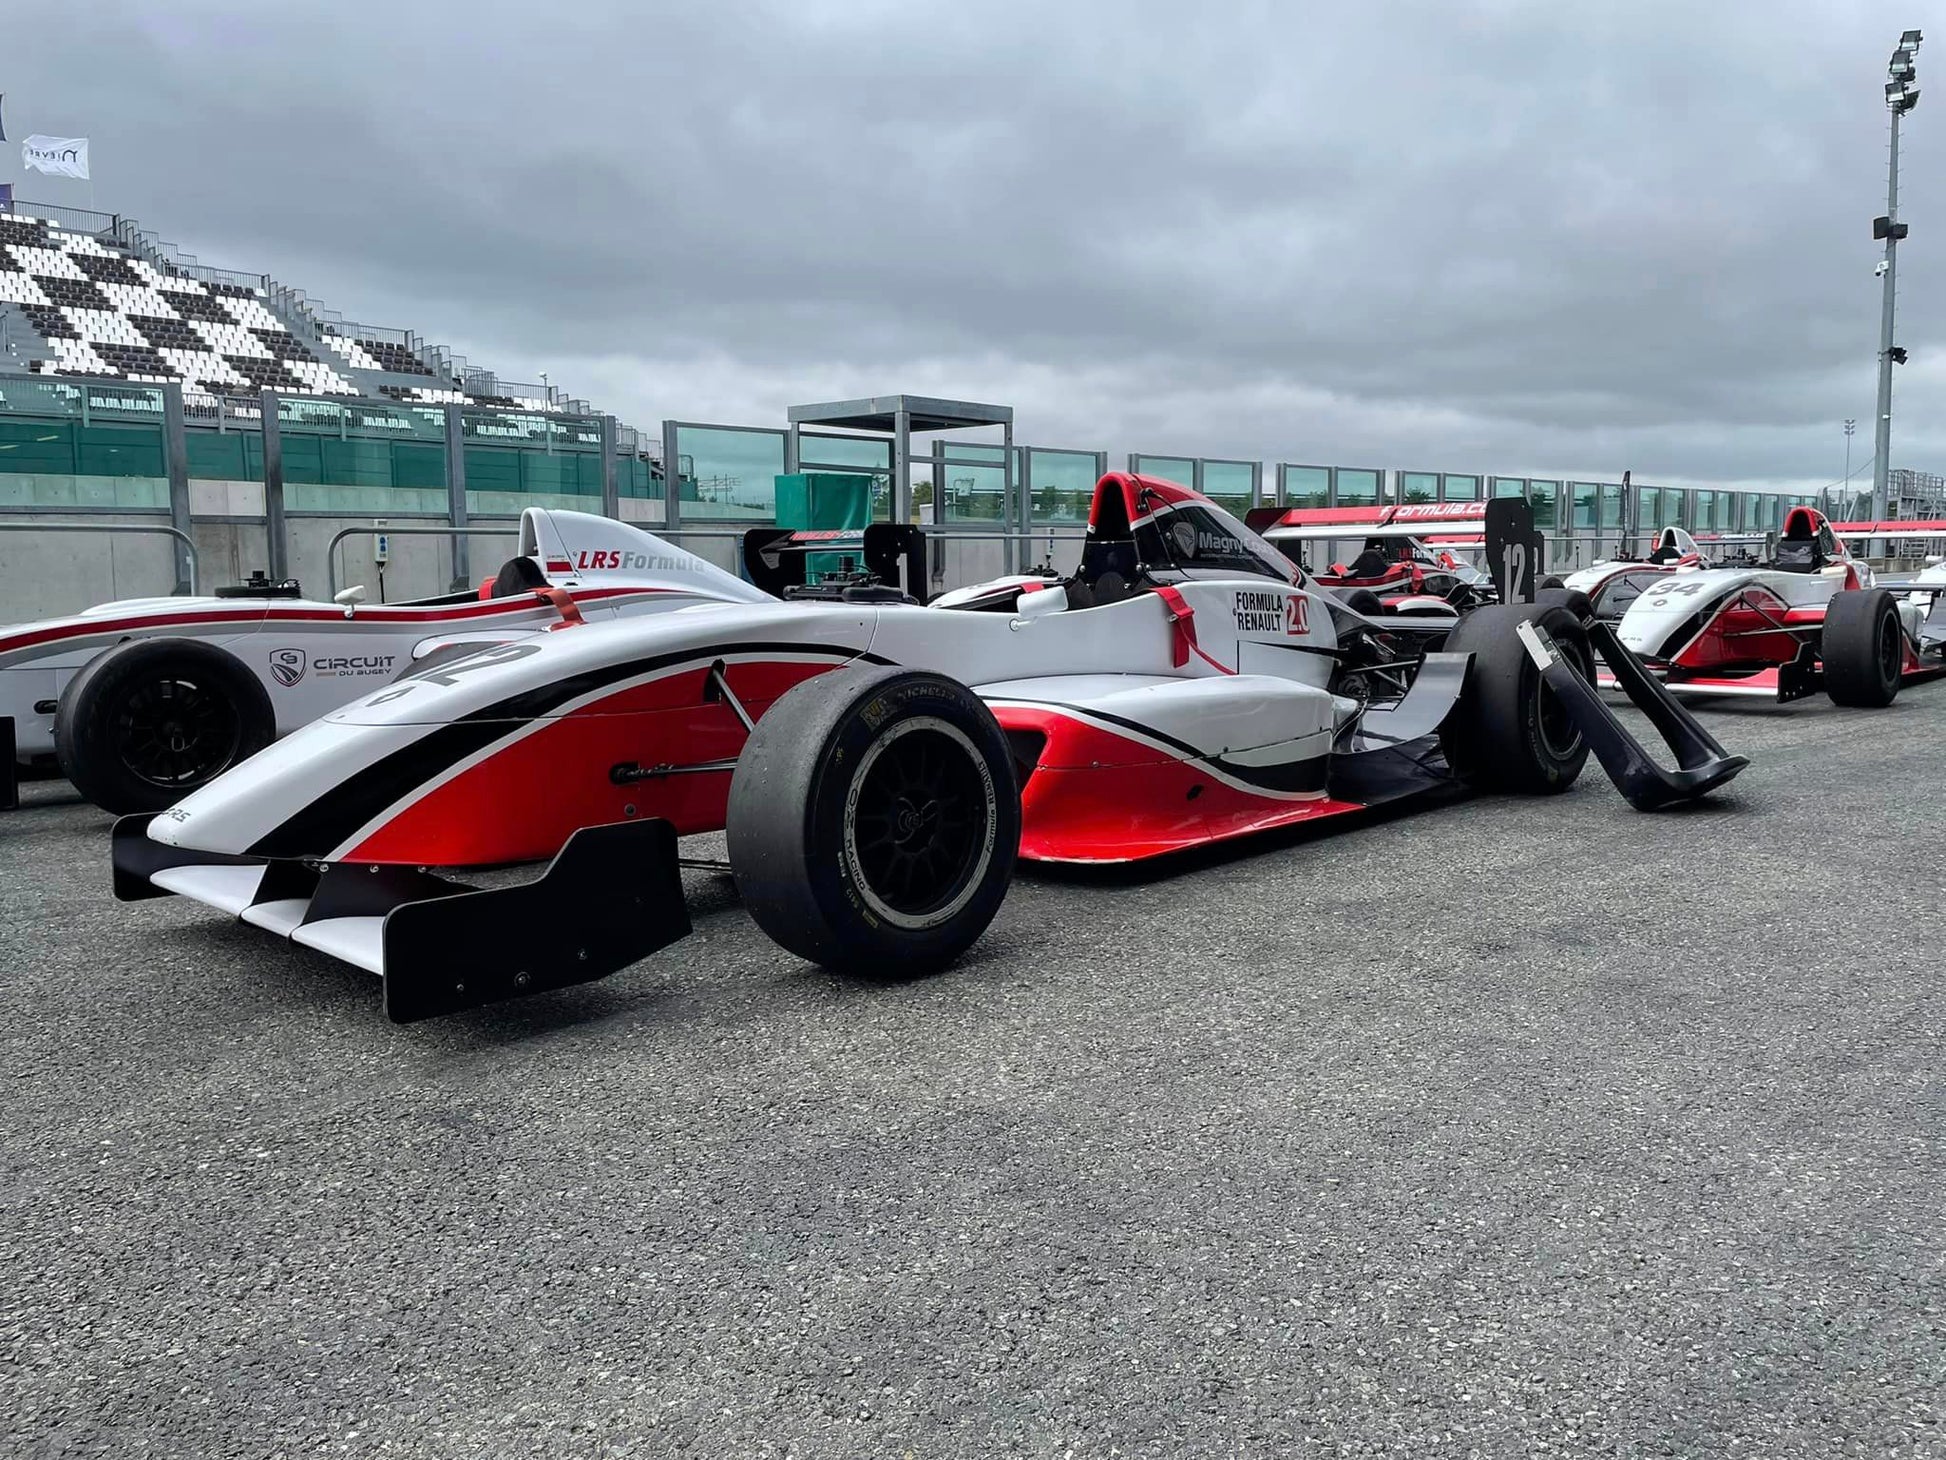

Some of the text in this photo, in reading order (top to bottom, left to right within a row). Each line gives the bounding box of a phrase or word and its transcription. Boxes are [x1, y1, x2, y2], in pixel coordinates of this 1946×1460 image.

[1502, 543, 1526, 604] 12
[1648, 582, 1705, 596] 34
[1236, 592, 1283, 612] FORMULA
[1238, 613, 1281, 631] RENAULT
[356, 668, 392, 676] BUGEY
[846, 839, 866, 891] RACING
